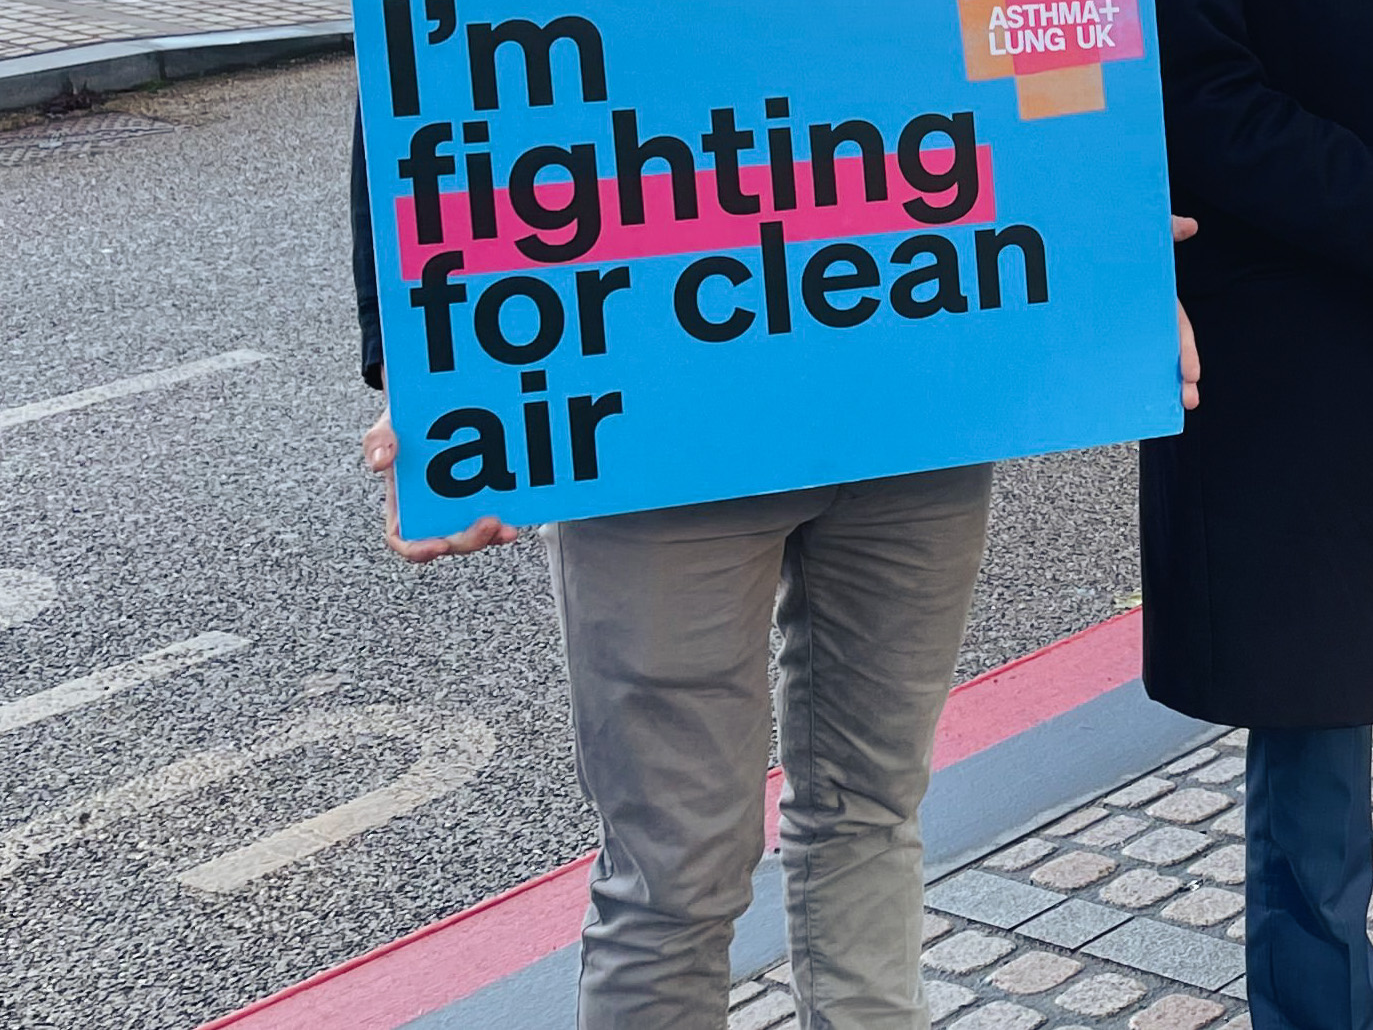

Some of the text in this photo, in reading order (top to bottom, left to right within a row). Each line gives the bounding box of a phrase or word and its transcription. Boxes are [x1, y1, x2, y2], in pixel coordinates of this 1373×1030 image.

[988, 0, 1120, 30] ASTHMA+
[989, 23, 1116, 56] LUNG UK
[398, 96, 980, 263] fighting
[410, 220, 1050, 373] for clean
[425, 369, 623, 499] air
